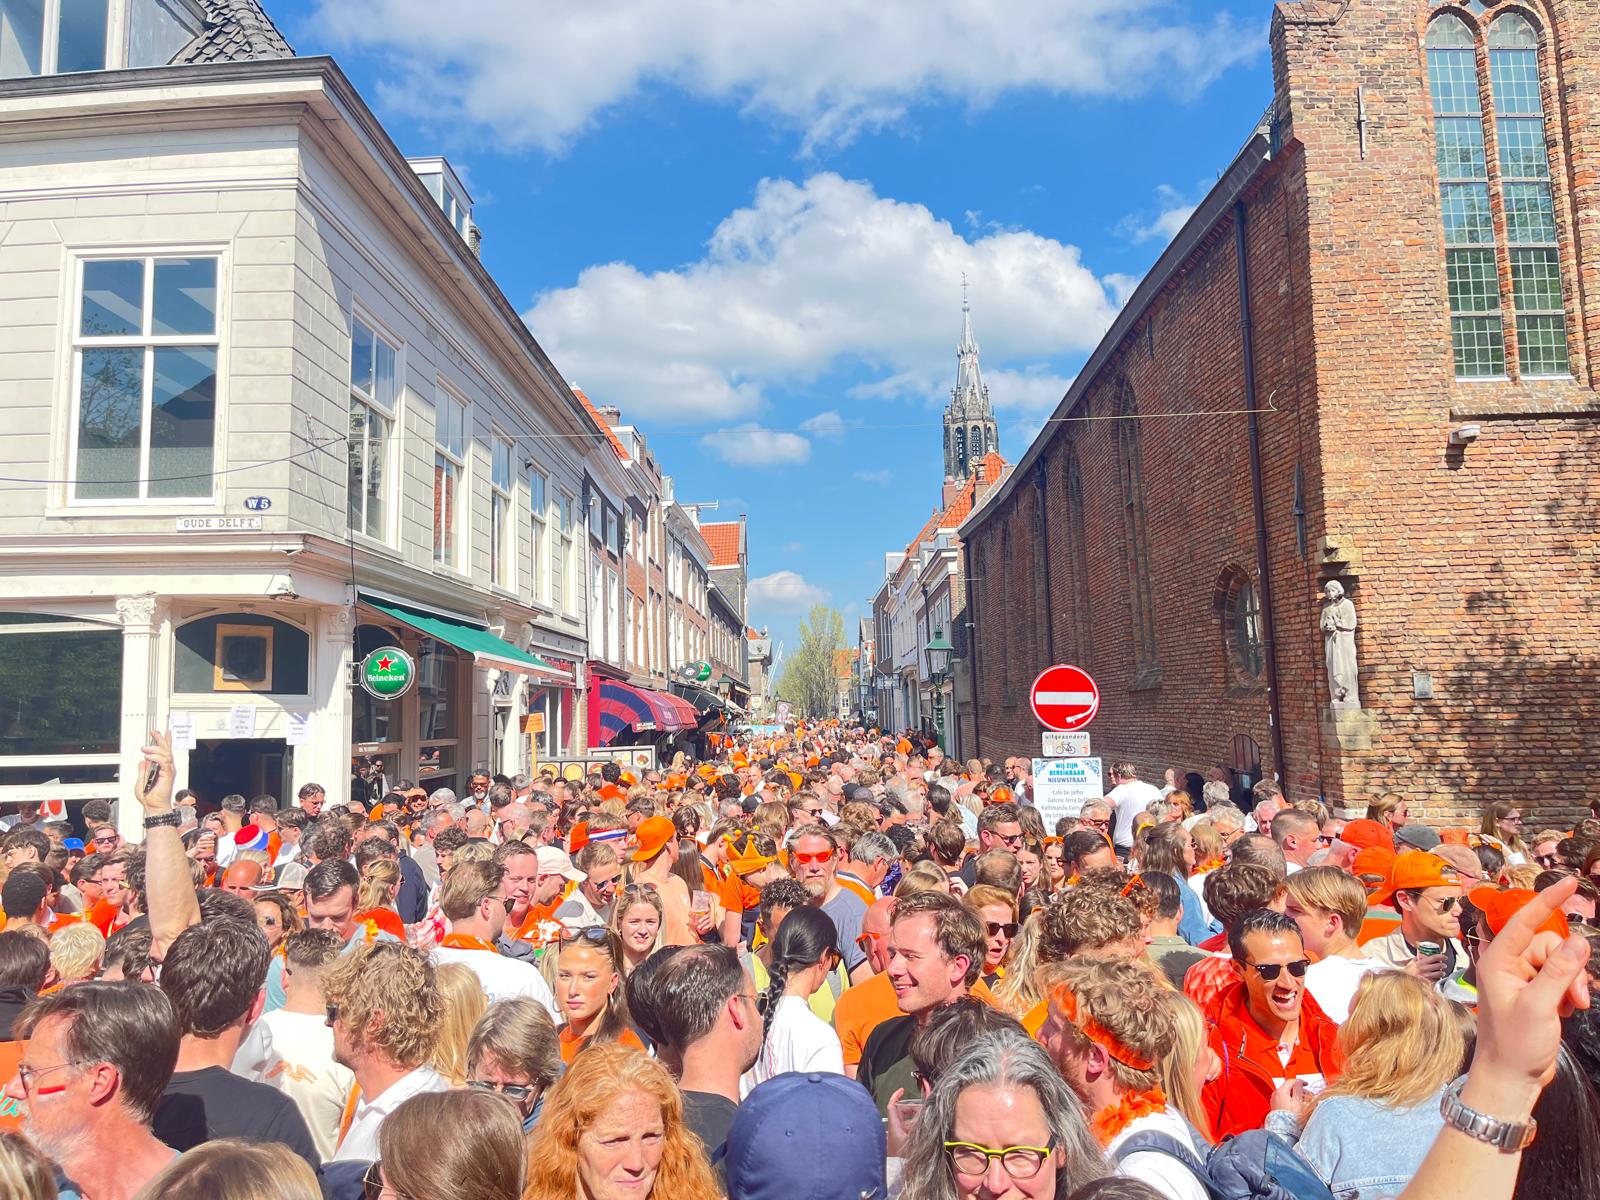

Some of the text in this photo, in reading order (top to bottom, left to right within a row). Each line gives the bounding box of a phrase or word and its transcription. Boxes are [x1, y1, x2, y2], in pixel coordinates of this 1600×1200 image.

[248, 499, 269, 508] W 5
[184, 518, 255, 528] OUDE DELFT
[367, 674, 405, 682] Heineken
